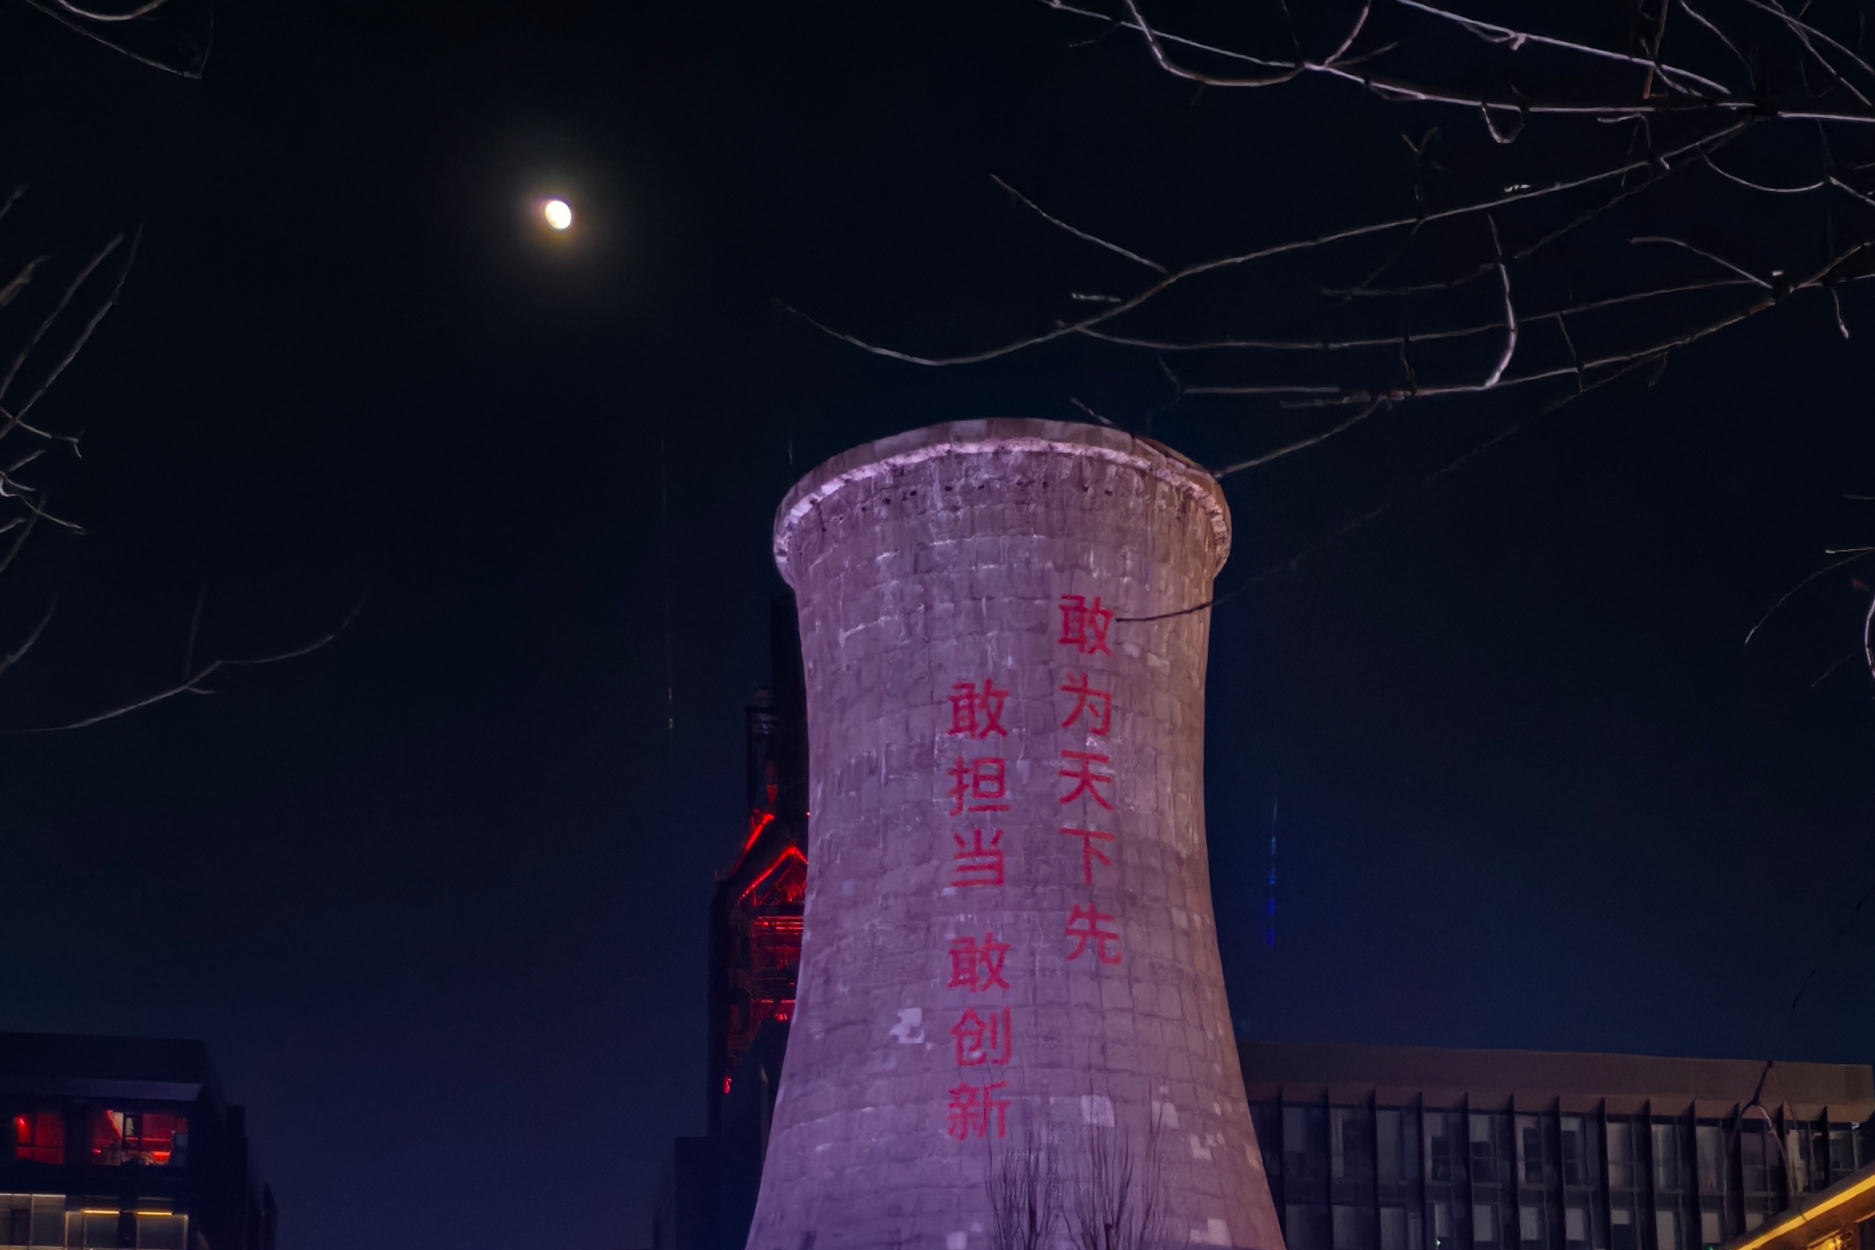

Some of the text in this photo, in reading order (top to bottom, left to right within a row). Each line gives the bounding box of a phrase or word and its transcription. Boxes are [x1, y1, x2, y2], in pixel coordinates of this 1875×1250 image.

[1058, 594, 1122, 965] 敢为天下先
